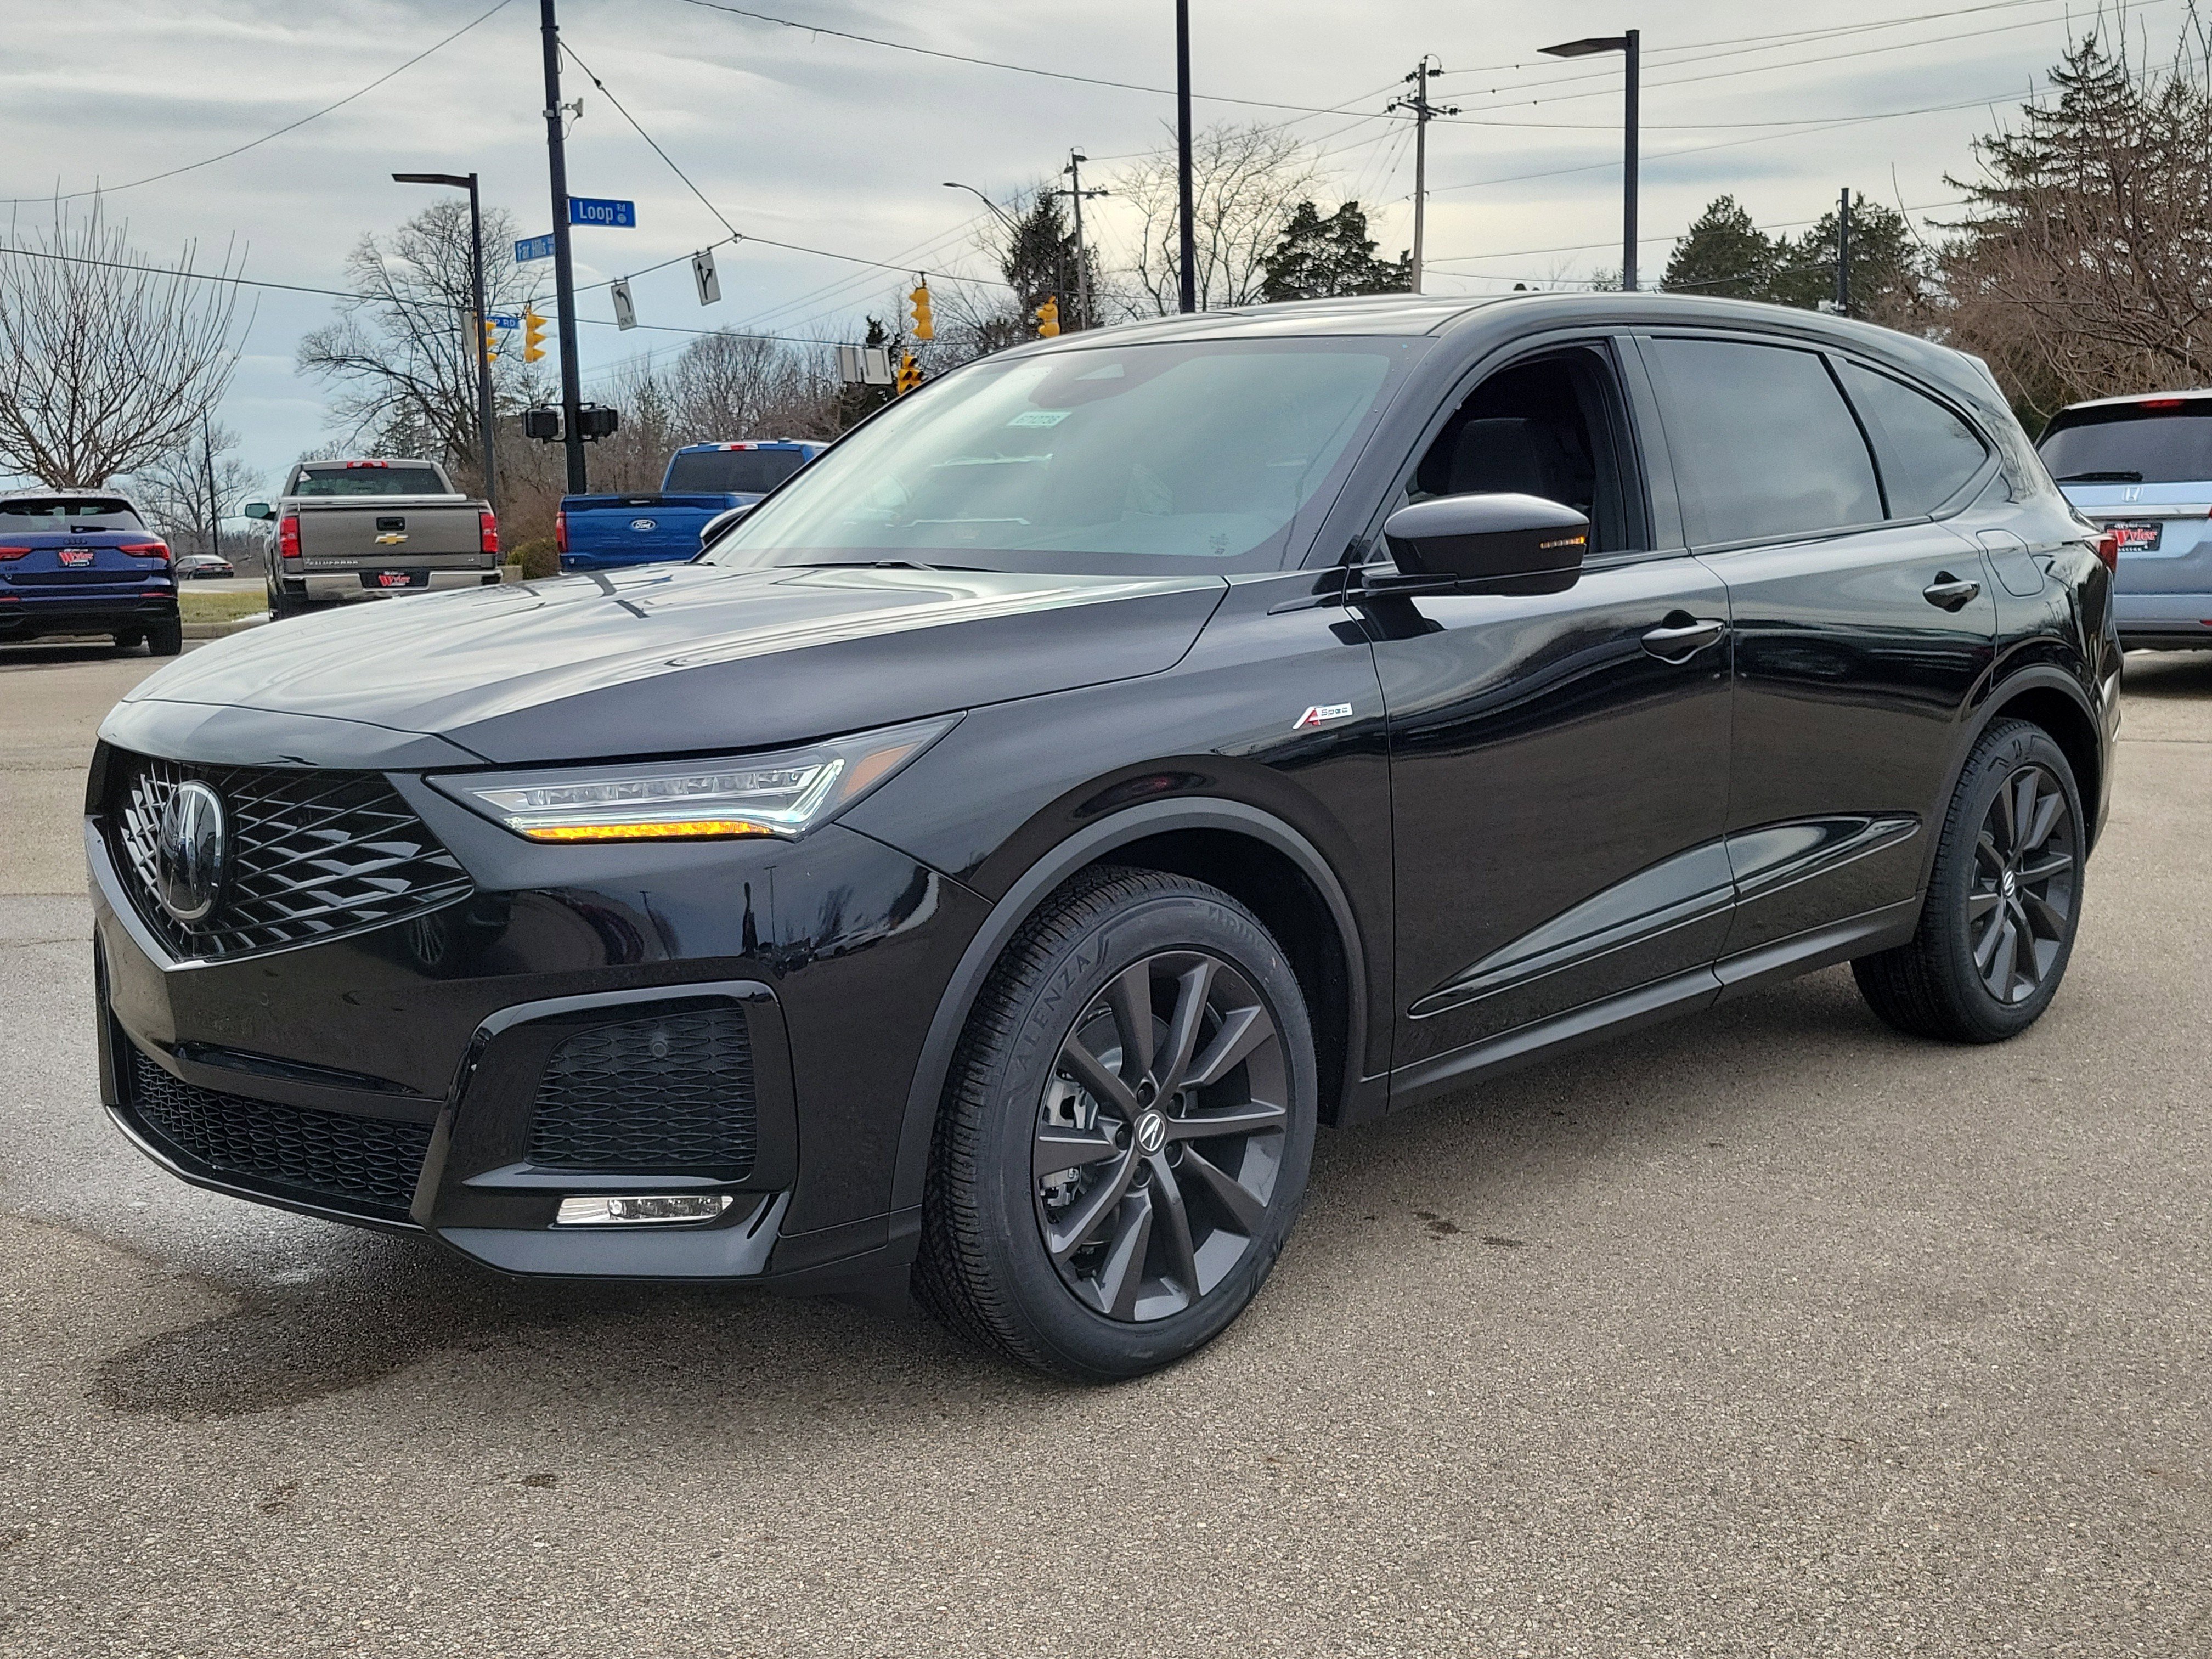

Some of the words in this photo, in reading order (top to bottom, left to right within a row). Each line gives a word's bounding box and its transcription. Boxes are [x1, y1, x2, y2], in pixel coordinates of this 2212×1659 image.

[579, 201, 614, 224] Loop
[616, 203, 625, 212] Rd
[517, 242, 530, 261] Far
[503, 319, 516, 327] RD
[620, 315, 634, 326] ONLY
[1016, 955, 1091, 1072] ALENZA
